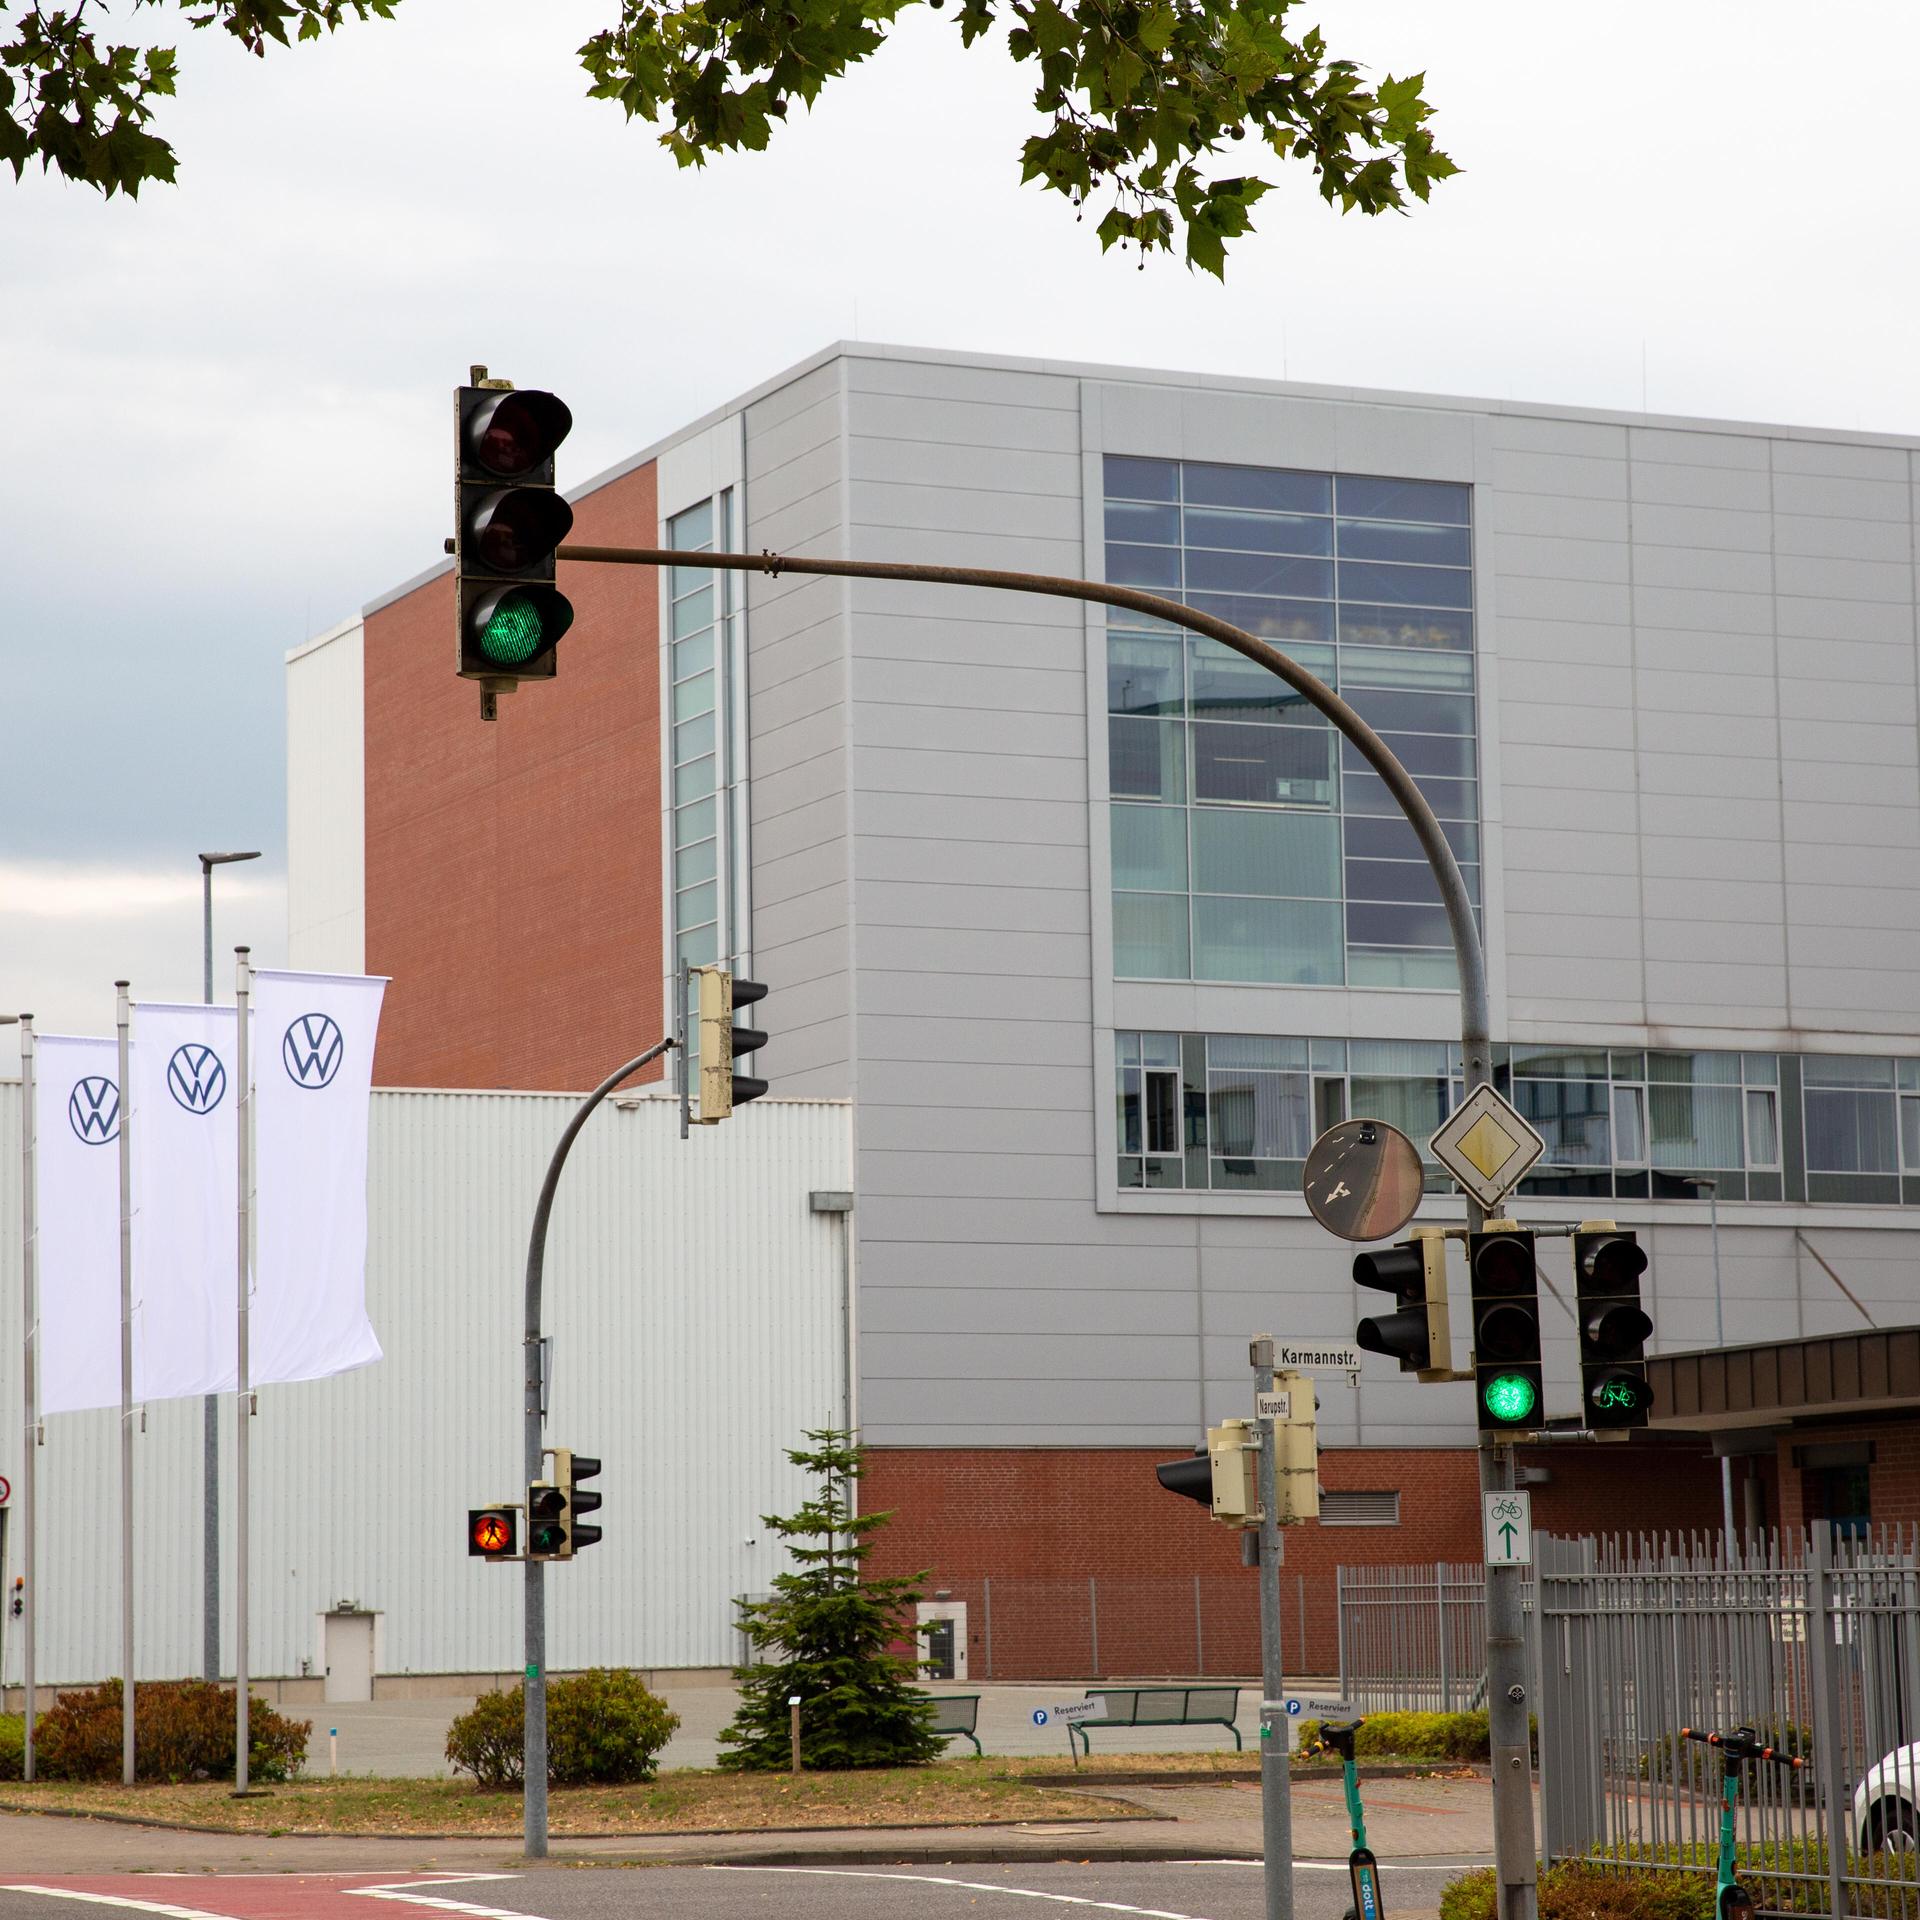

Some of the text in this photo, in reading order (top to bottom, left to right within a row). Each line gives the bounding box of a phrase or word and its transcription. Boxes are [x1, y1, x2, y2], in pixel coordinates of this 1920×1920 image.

[283, 1013, 343, 1090] VW
[168, 1043, 226, 1115] VW
[1282, 1348, 1357, 1365] Karmannstr.
[1350, 1374, 1357, 1386] 1
[1259, 1399, 1288, 1416] Narupstr.
[1054, 1702, 1095, 1715] Reserviert
[1309, 1700, 1351, 1712] Reserviert
[1362, 1884, 1375, 1911] dott
